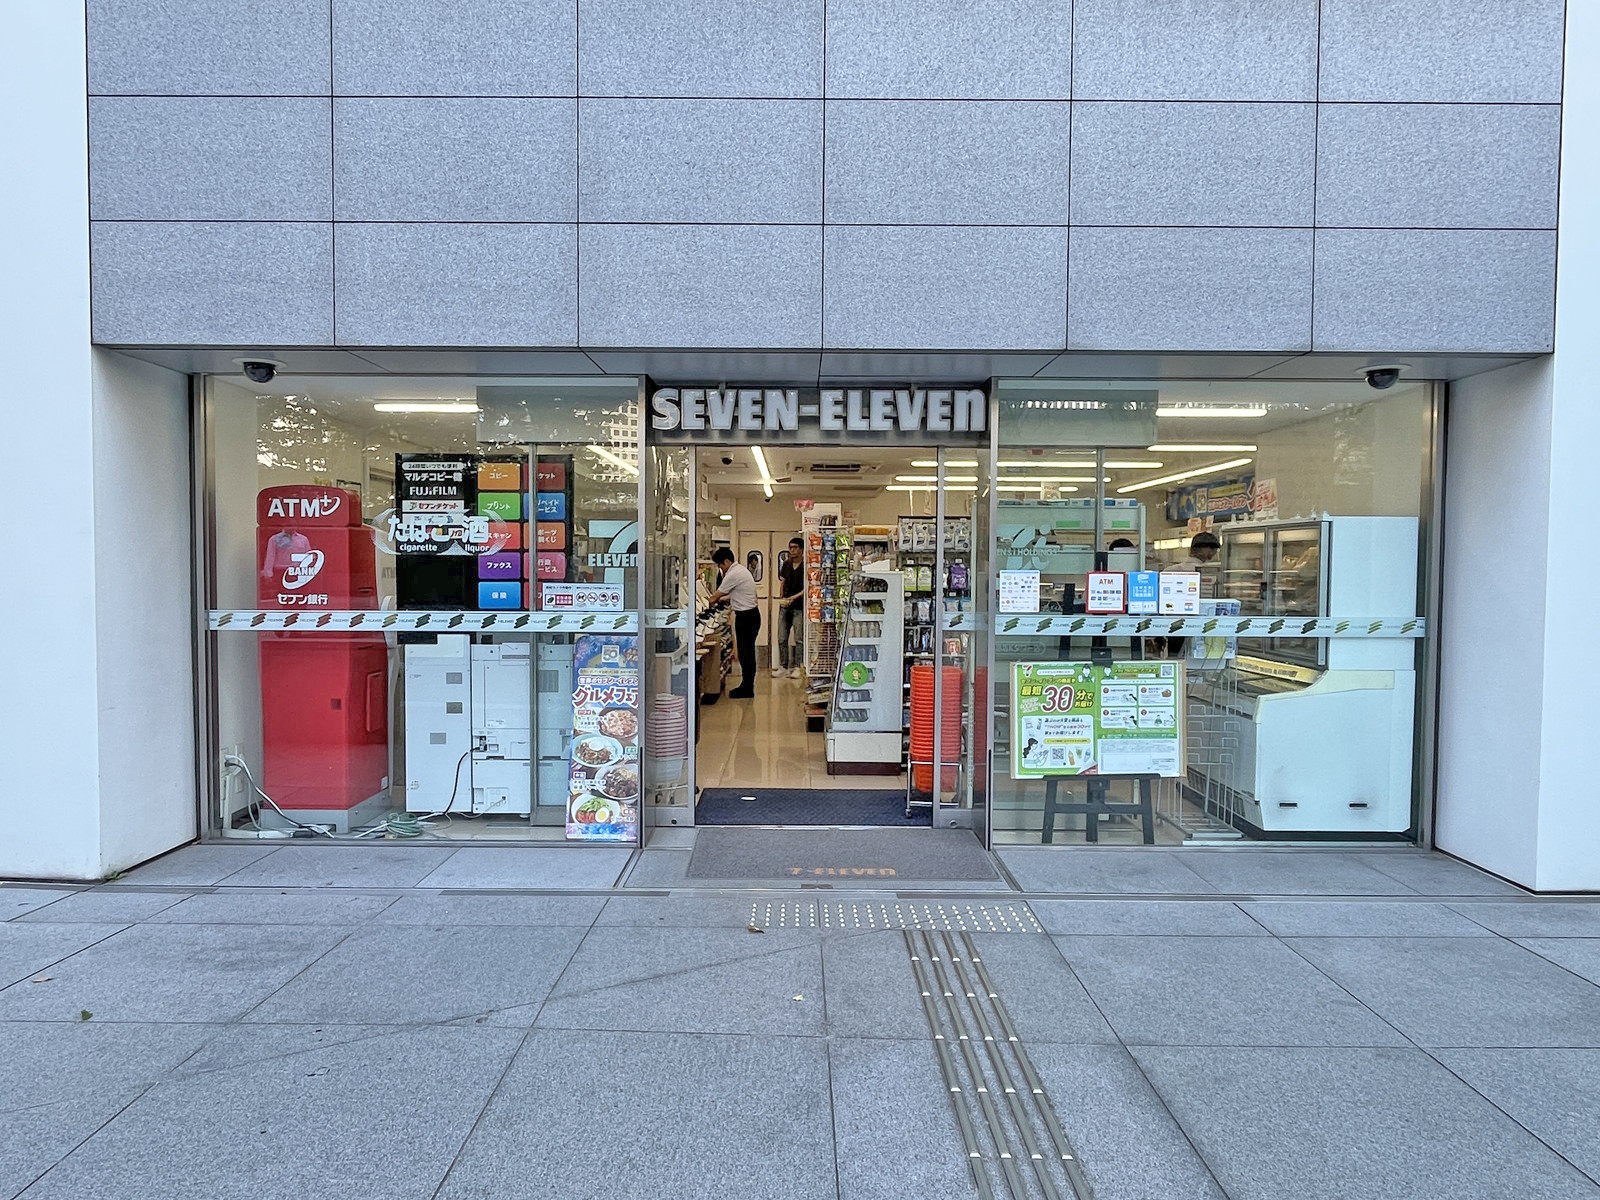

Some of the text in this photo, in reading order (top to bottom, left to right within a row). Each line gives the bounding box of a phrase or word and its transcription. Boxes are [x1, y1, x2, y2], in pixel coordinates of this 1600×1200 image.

[404, 472, 463, 482] マルチコピー機
[409, 486, 457, 495] FUJIFILM
[487, 501, 511, 510] プリント
[388, 514, 490, 543] たばこ 酒
[400, 543, 490, 552] cigarette liquor
[288, 567, 317, 576] BANK
[277, 593, 329, 605] セブン銀行
[1041, 685, 1074, 712] 30
